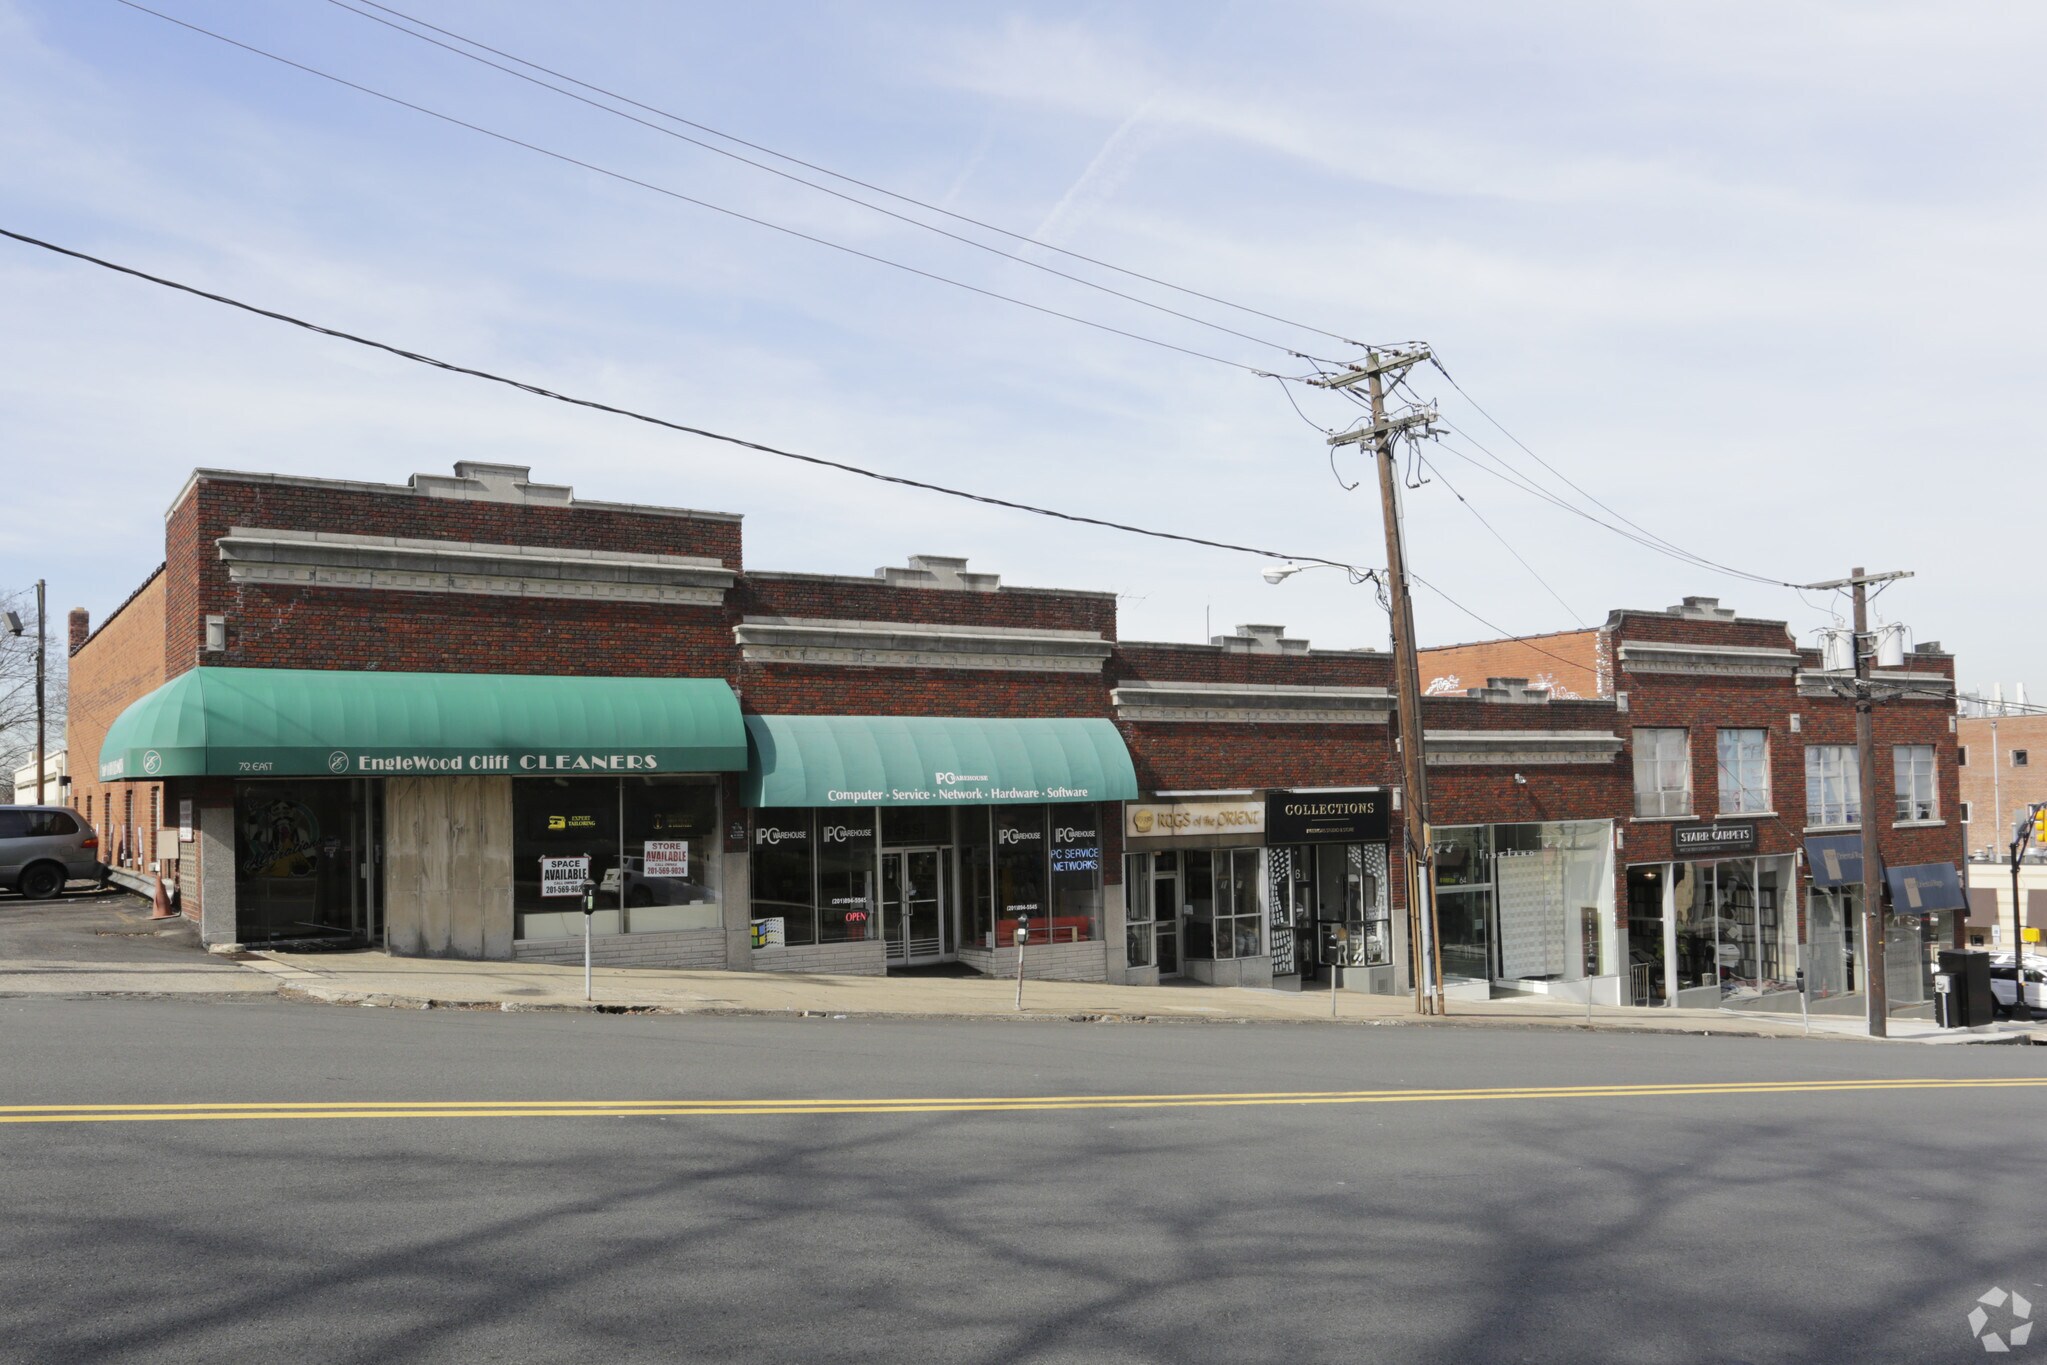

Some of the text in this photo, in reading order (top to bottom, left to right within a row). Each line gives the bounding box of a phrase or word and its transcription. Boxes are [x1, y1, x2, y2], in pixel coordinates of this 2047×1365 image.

[238, 762, 273, 771] 72 EAST
[358, 754, 658, 771] EngleWood Cliff CLEANERS
[827, 786, 1088, 804] Computer Service Network Hardware Software
[1285, 802, 1375, 816] COLLECTIONS
[1157, 812, 1191, 829] RUGS
[1193, 815, 1202, 826] of
[1217, 810, 1260, 829] ORIENT
[756, 827, 780, 845] PC
[773, 831, 807, 839] WAREHOUSE
[823, 825, 847, 843] PC
[840, 829, 872, 837] WAREHOUSE
[999, 828, 1041, 845] PC WAREHOUSE
[1055, 827, 1096, 843] PC WAREHOUSE
[1680, 829, 1750, 842] STARR CARPETS
[652, 842, 681, 850] STORE
[645, 850, 687, 862] AVAILABLE
[1050, 847, 1099, 859] PC SERVICE
[551, 860, 581, 868] SPACE
[647, 866, 685, 875] 201-569-9024
[1053, 859, 1099, 872] NETWORKS
[544, 868, 587, 881] AVAILABLE
[546, 884, 583, 894] 201-569-902
[845, 911, 867, 922] OPEN
